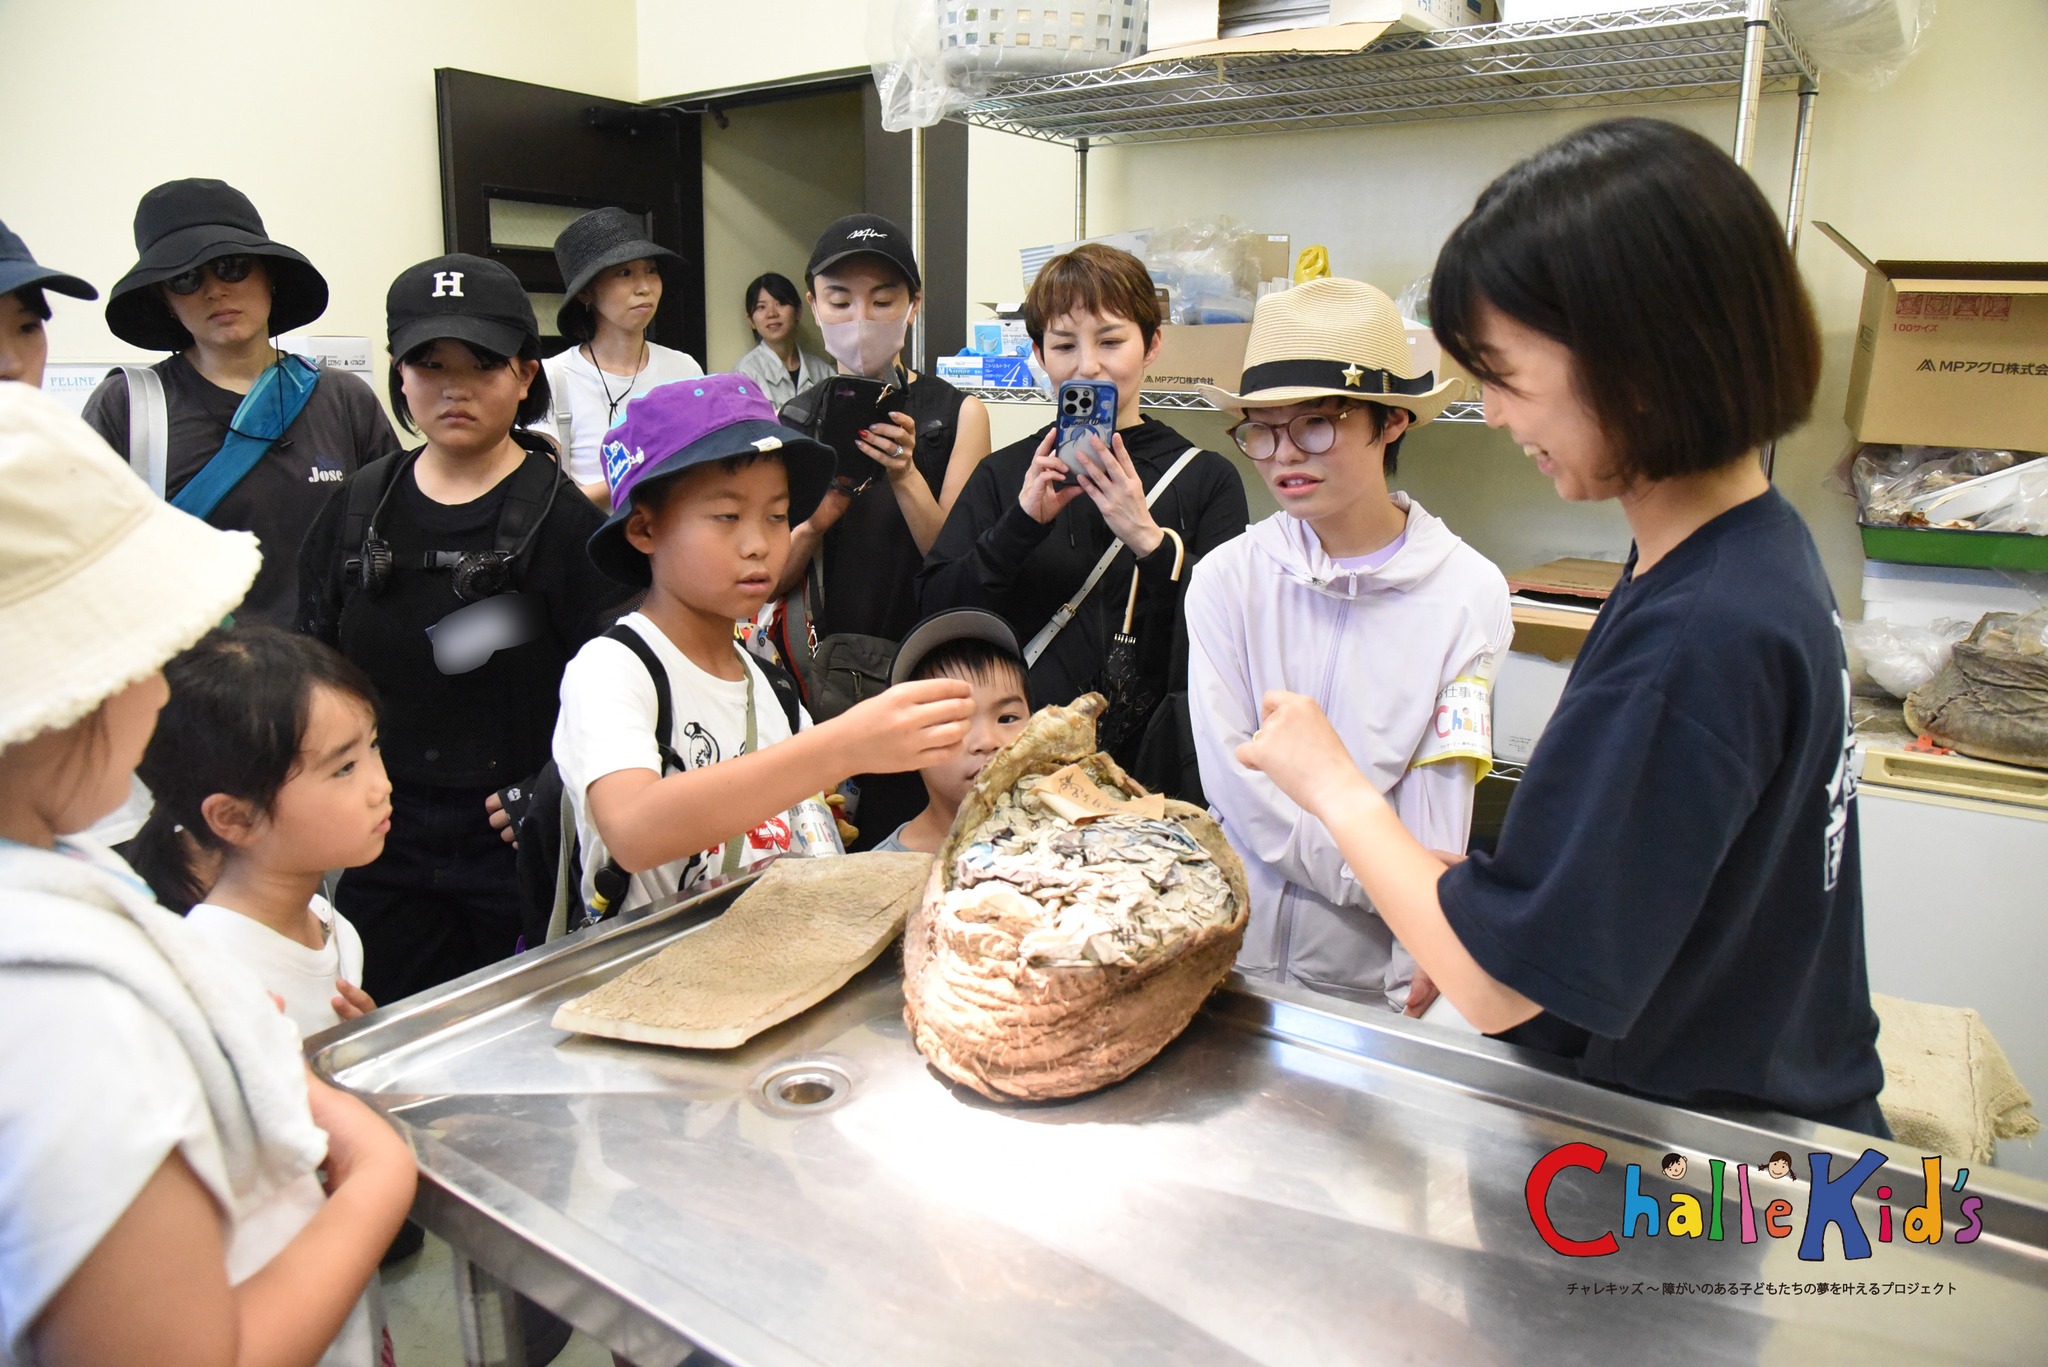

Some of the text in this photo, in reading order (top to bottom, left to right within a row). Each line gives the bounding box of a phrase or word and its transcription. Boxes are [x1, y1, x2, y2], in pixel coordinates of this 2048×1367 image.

[432, 271, 465, 298] H
[1892, 323, 1939, 333] 100サイズ
[50, 376, 97, 387] FELINE
[308, 466, 344, 483] Jose
